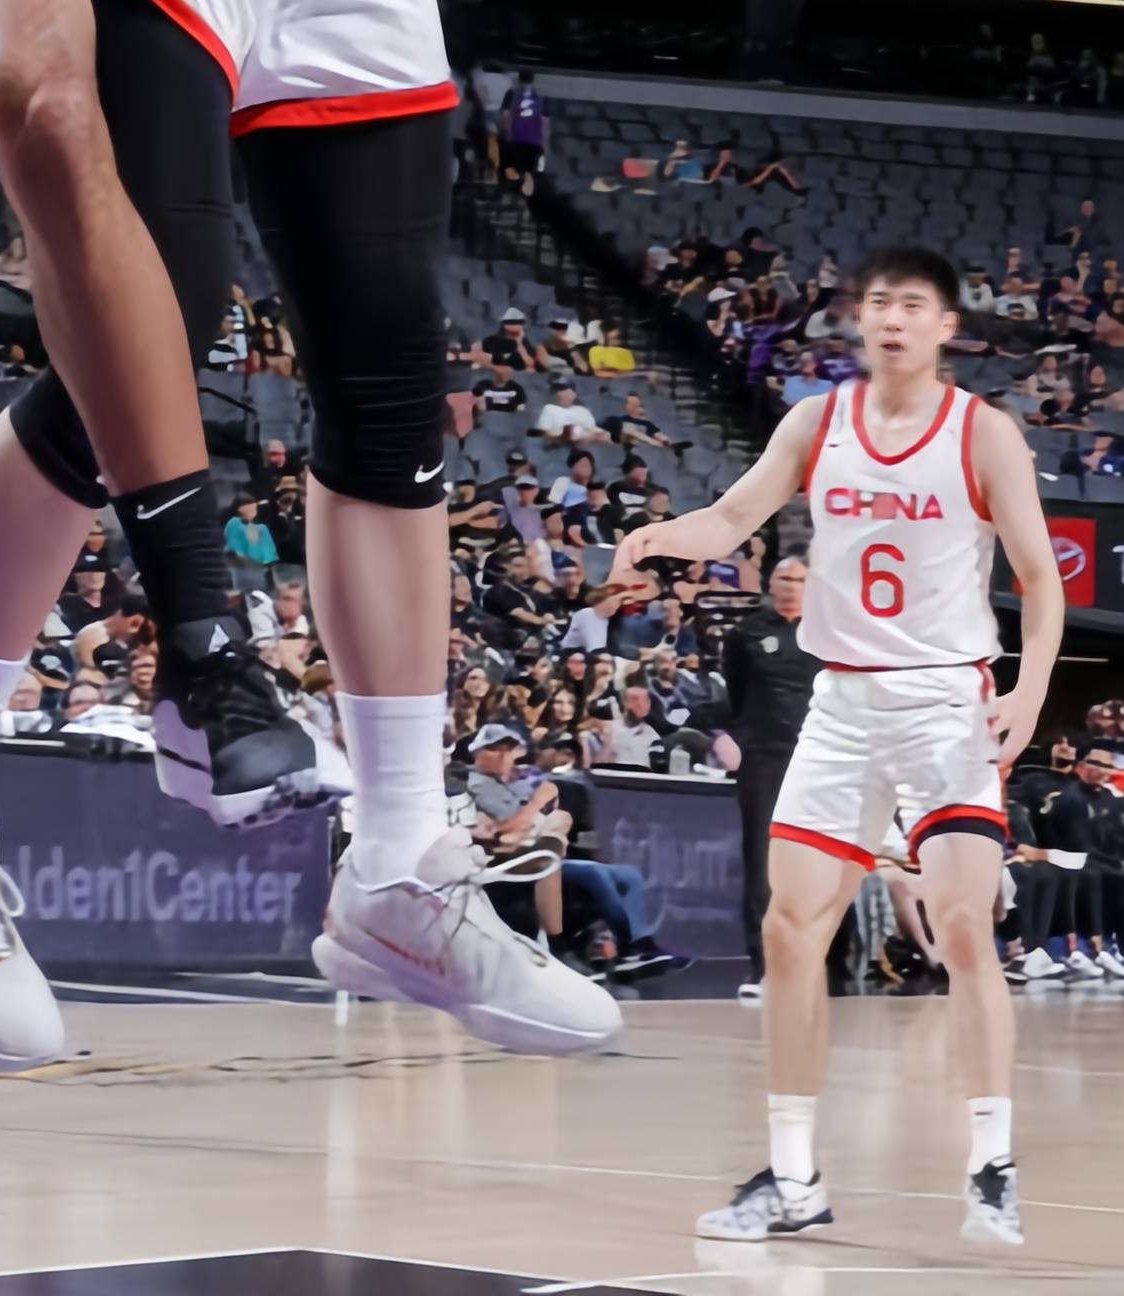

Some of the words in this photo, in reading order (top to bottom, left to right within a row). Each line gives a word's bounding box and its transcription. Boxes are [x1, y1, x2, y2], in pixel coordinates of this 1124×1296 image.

[825, 488, 943, 520] CHINA
[860, 543, 905, 618] 6
[2, 845, 302, 922] lden1Center
